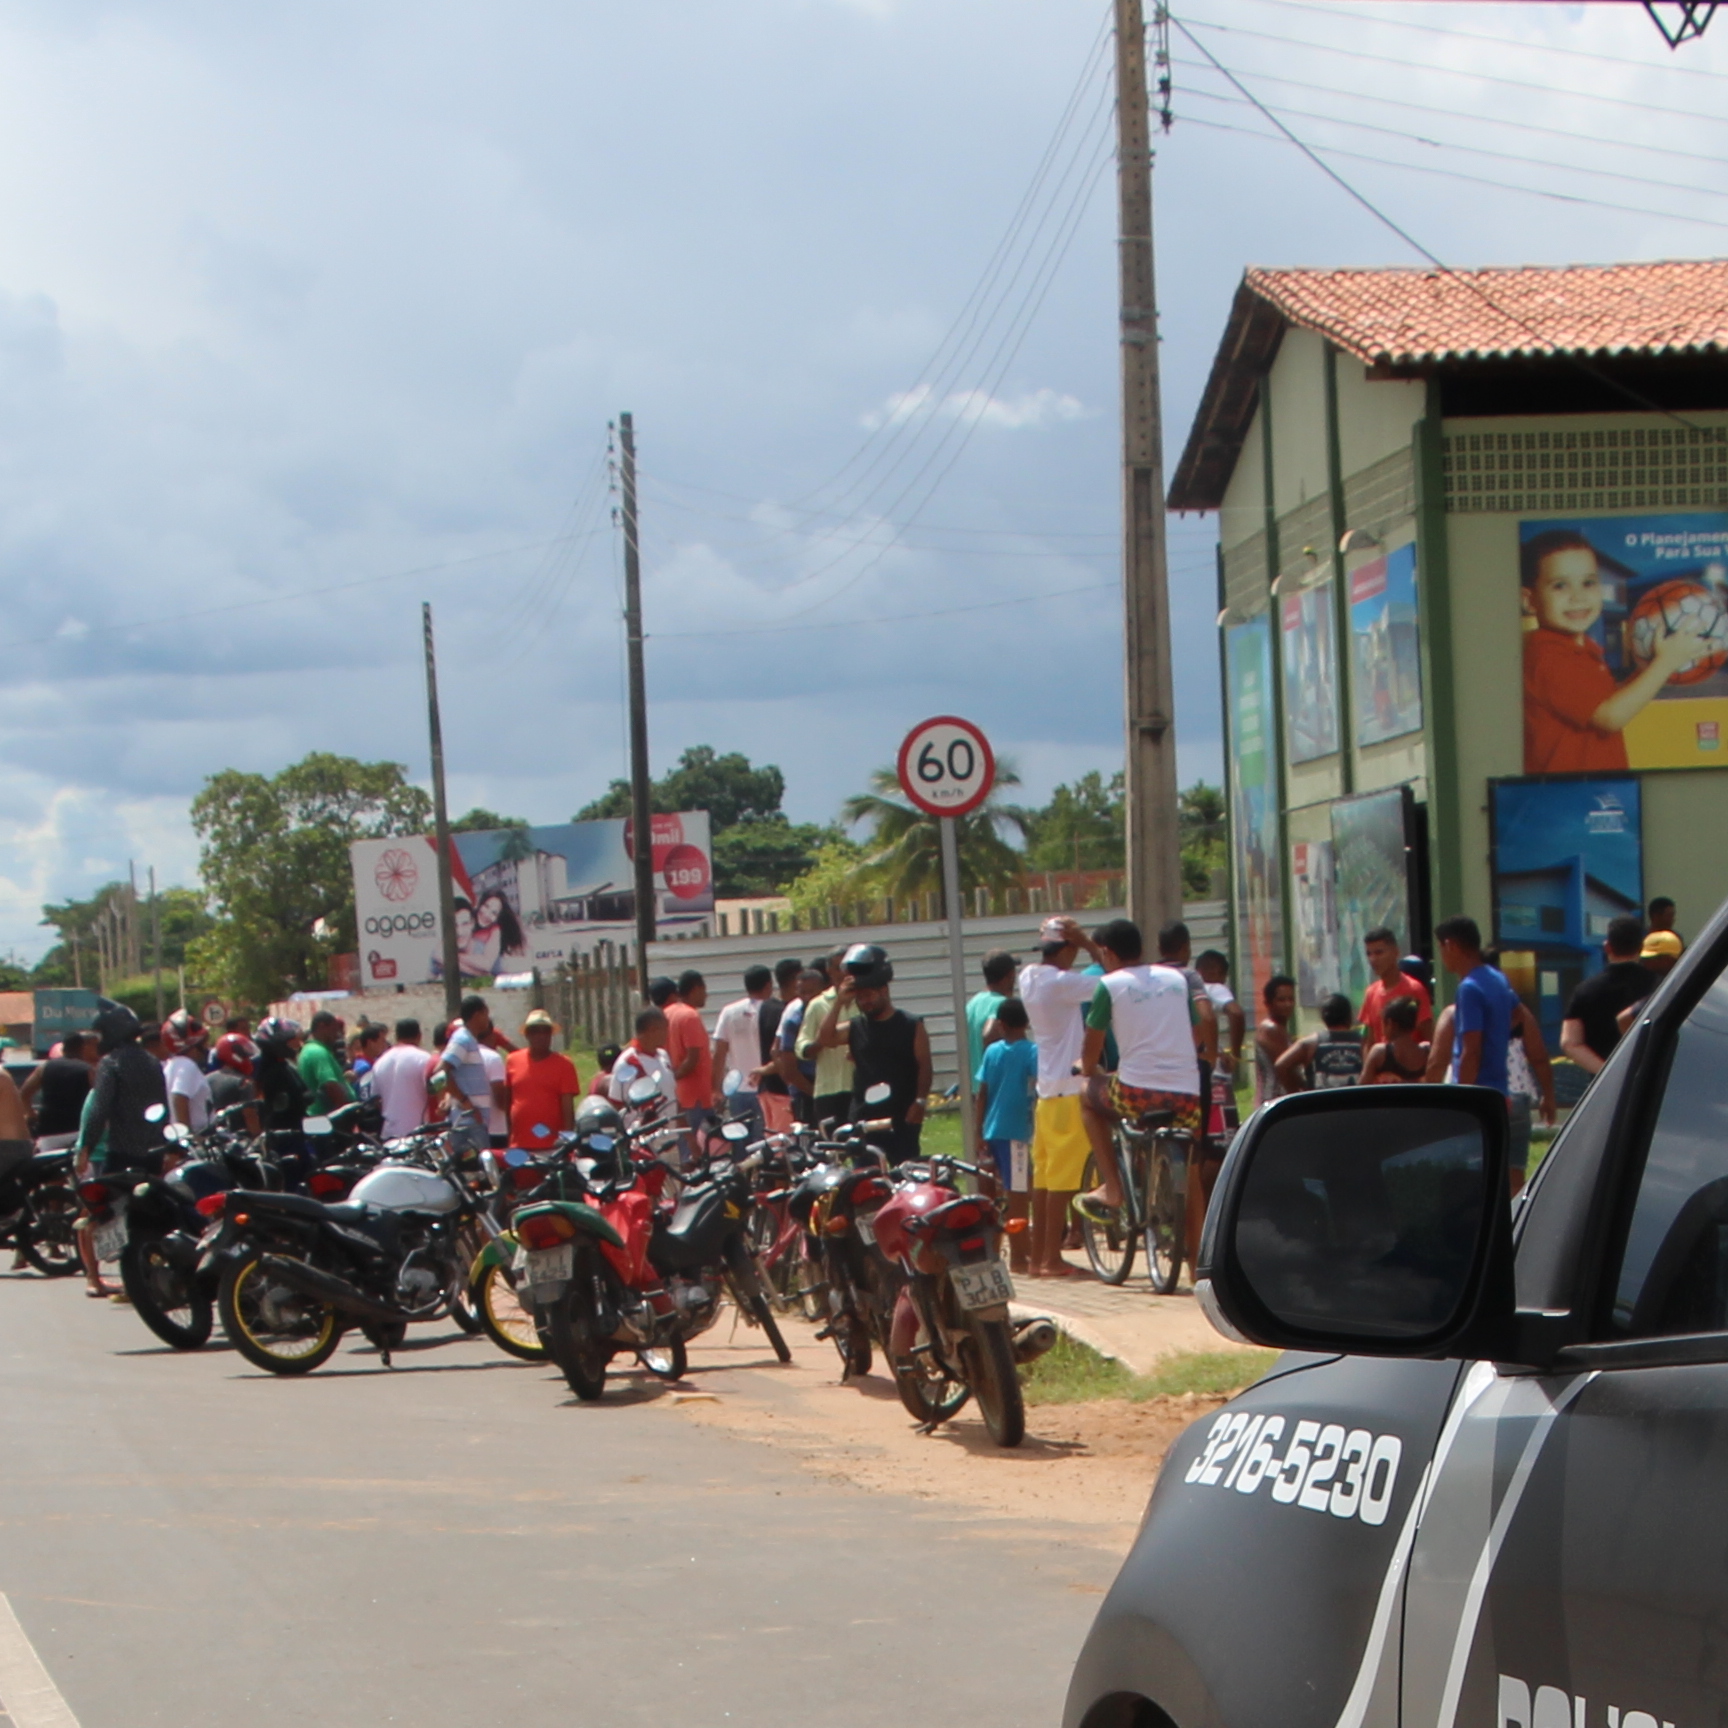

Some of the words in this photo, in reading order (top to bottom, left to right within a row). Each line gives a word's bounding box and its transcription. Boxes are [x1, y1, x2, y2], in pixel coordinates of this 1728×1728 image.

[1625, 534, 1637, 546] O
[1655, 546, 1690, 559] Para
[1694, 545, 1721, 557] Sua
[918, 739, 974, 782] 60
[932, 788, 964, 798] km/h
[671, 868, 702, 886] 199
[365, 912, 435, 938] agape
[1184, 1412, 1402, 1526] 3216-5230
